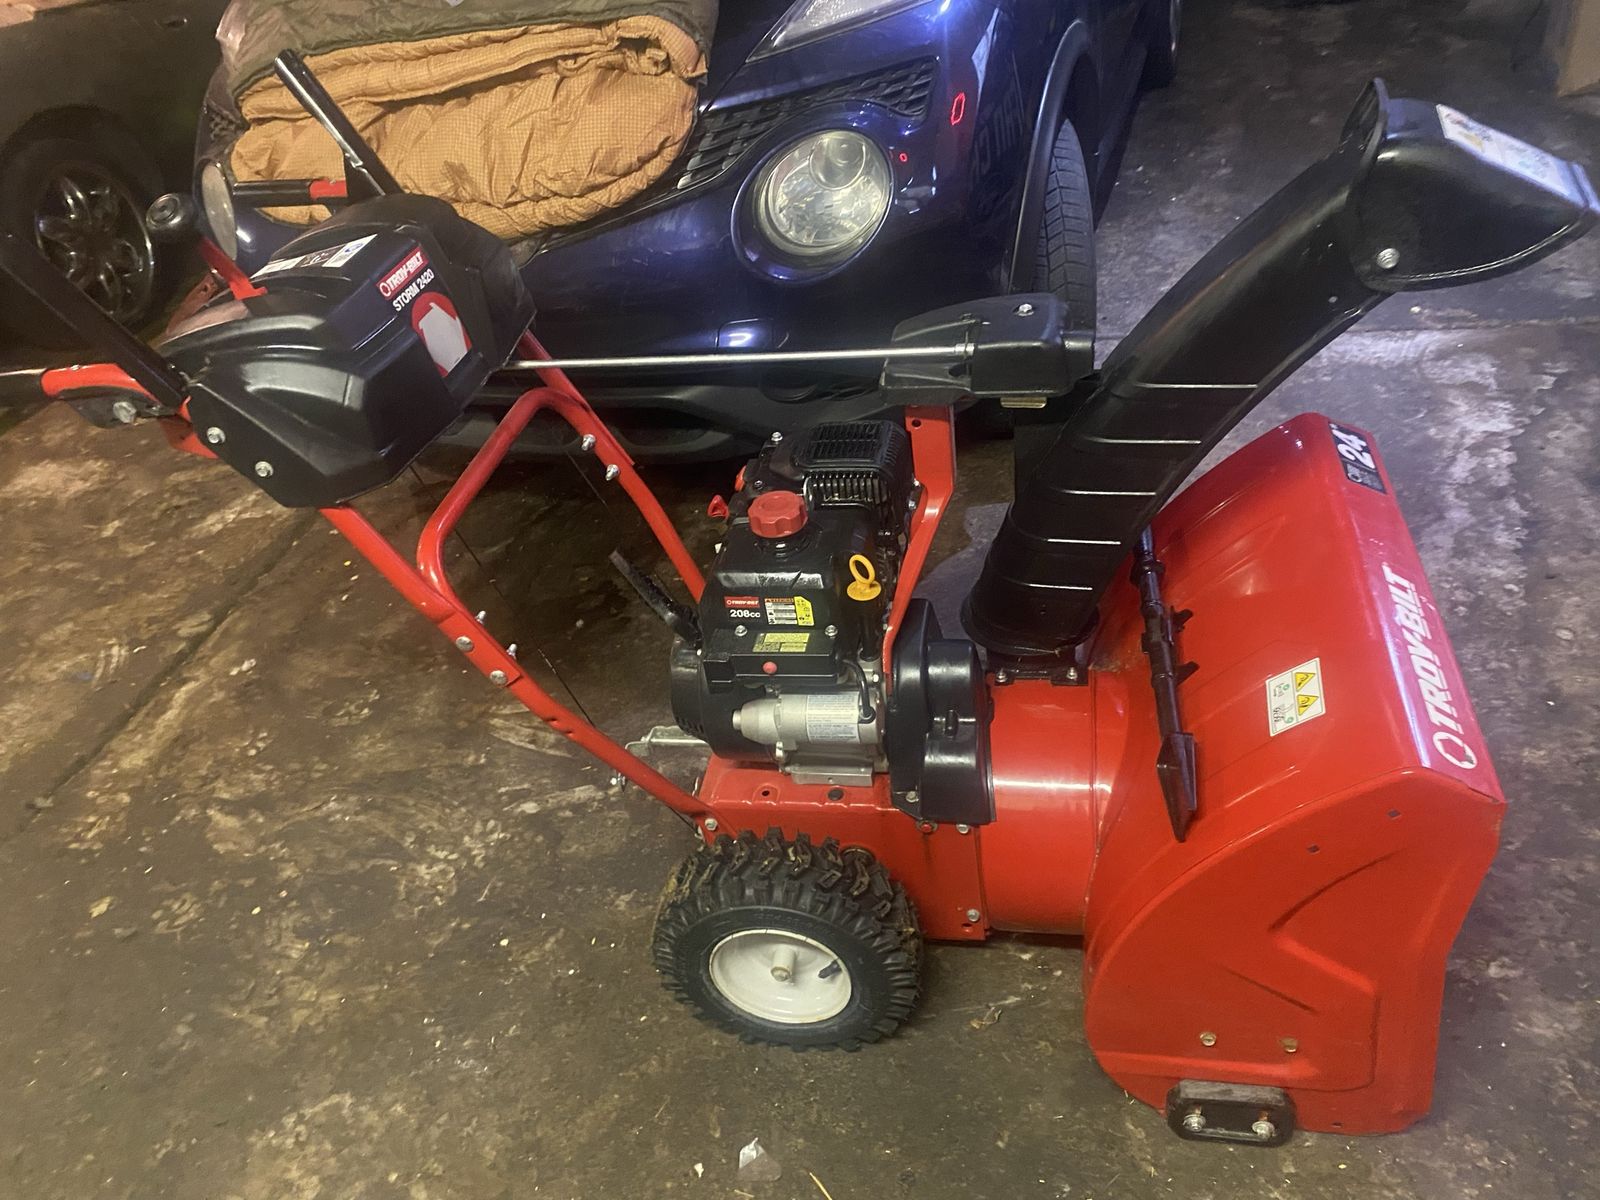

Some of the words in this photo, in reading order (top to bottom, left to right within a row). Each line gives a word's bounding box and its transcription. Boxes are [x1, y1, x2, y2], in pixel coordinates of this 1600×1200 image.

[386, 251, 424, 291] TROY-BILT
[392, 285, 420, 312] STORM
[416, 268, 435, 290] 2420
[730, 609, 761, 618] 208cc
[1382, 562, 1464, 735] TROY-BILT
